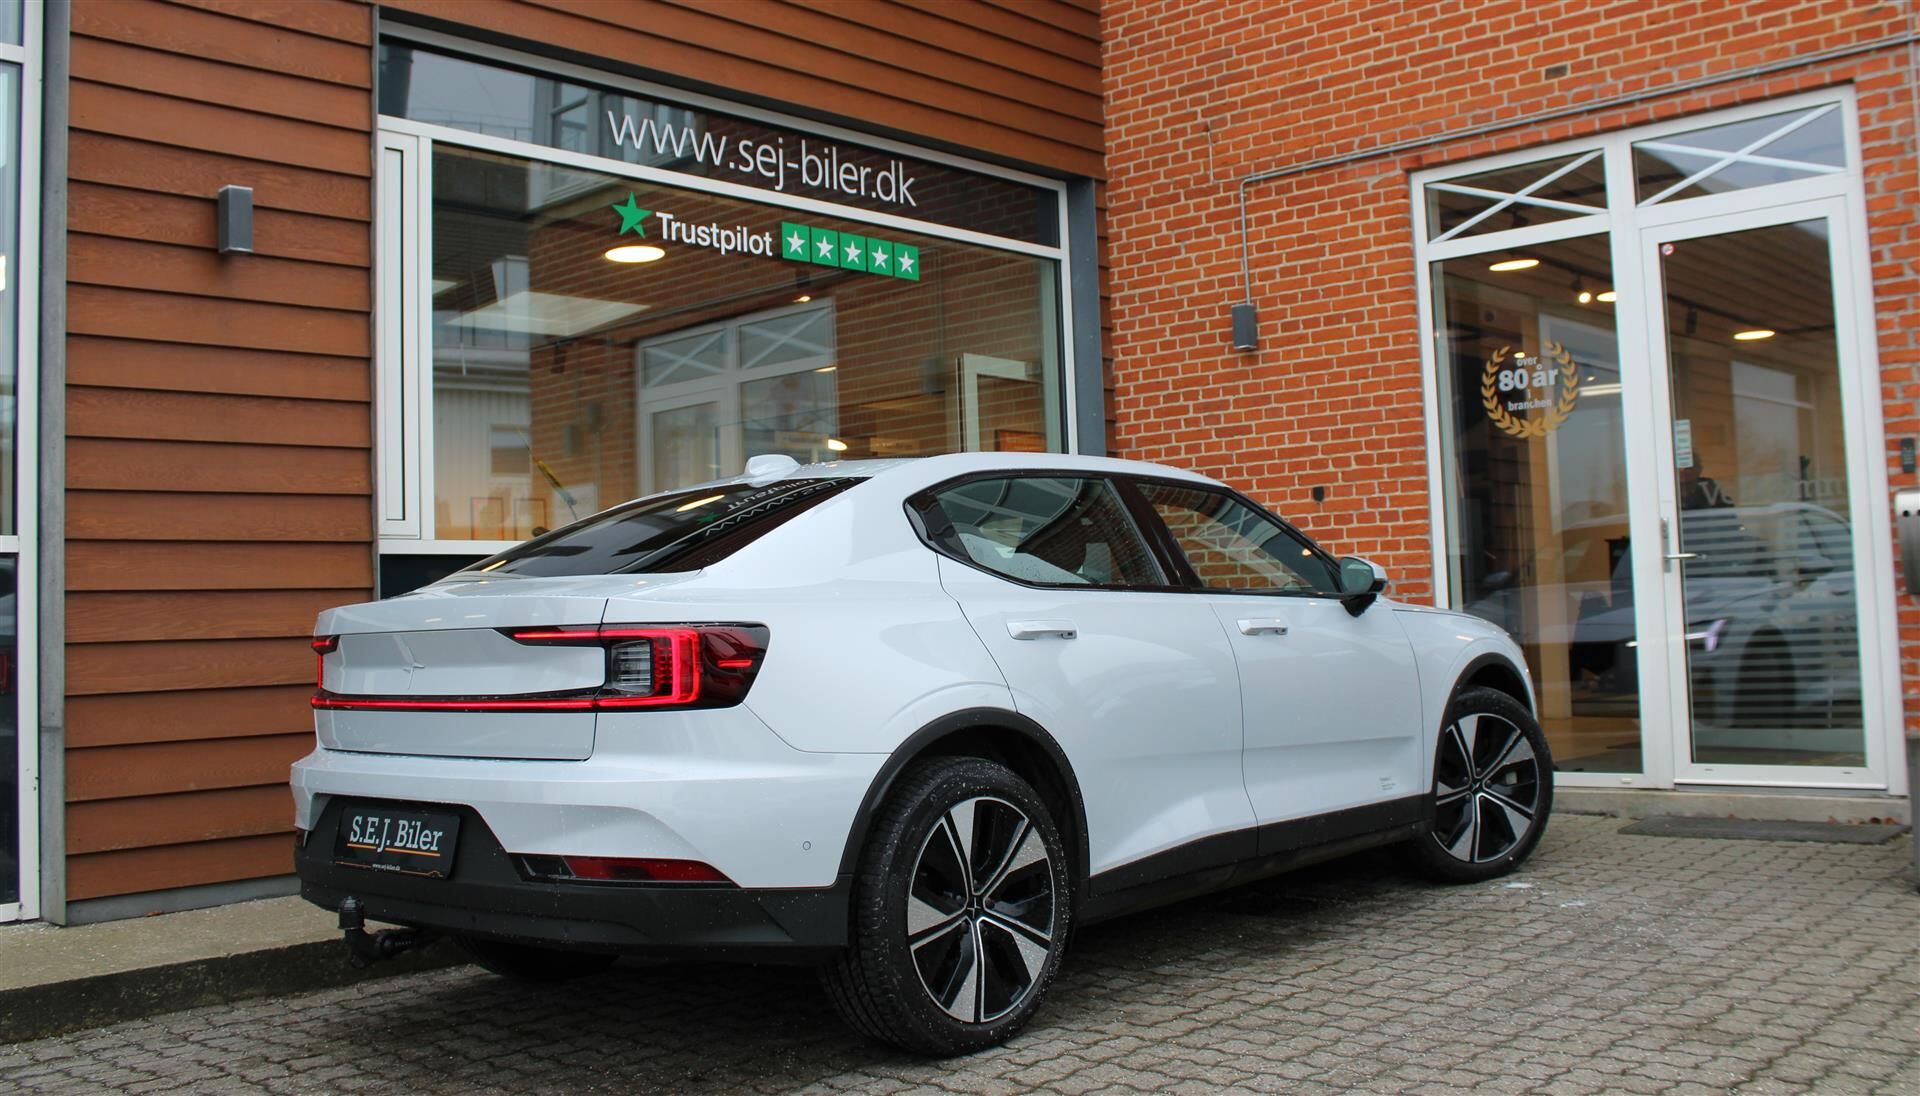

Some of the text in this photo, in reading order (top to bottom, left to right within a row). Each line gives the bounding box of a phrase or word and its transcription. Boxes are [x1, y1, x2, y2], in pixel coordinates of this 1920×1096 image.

[607, 110, 917, 207] www.sej-biler.dk
[656, 212, 773, 256] Trustpilot
[1499, 364, 1559, 391] 80 år
[1517, 356, 1538, 367] over
[1507, 399, 1553, 412] branchen
[349, 815, 442, 853] S.E.J. Biler
